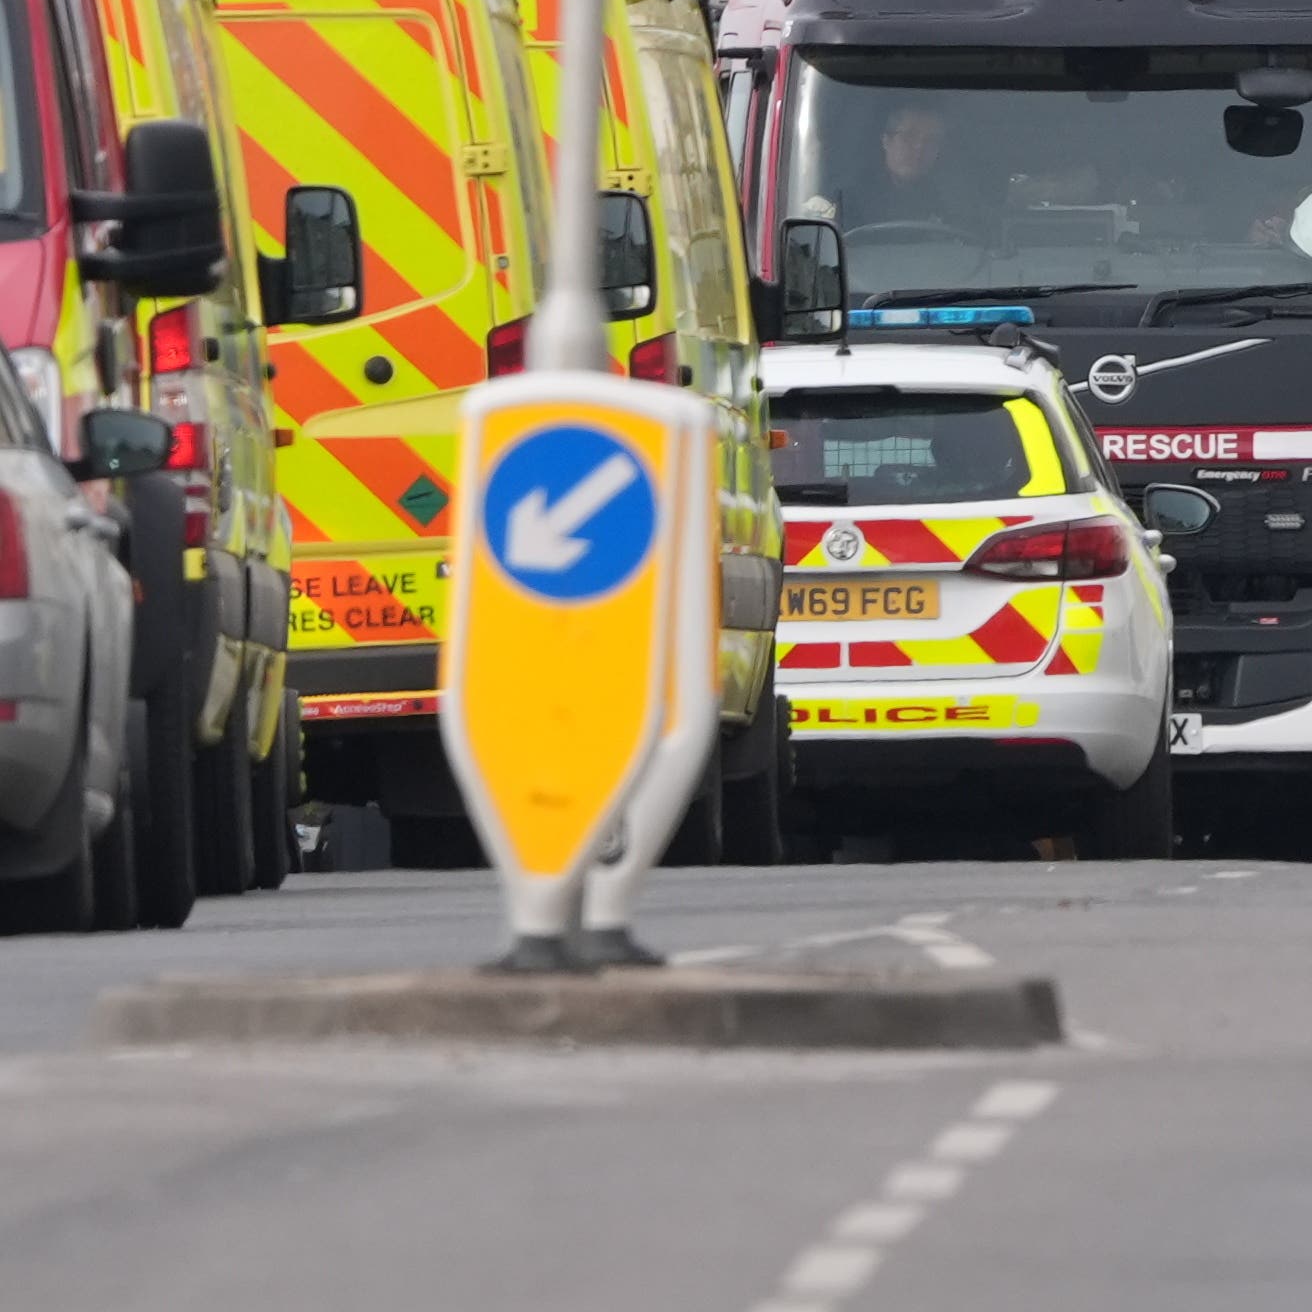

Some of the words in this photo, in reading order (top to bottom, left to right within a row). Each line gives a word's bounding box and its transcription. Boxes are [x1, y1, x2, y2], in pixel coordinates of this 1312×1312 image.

[1093, 375, 1133, 383] VOLVO
[1103, 433, 1238, 461] RESCUE
[1196, 469, 1260, 482] Emergency
[332, 574, 417, 597] LEAVE
[778, 587, 850, 616] W69
[861, 586, 925, 615] FCG
[345, 605, 435, 630] CLEAR
